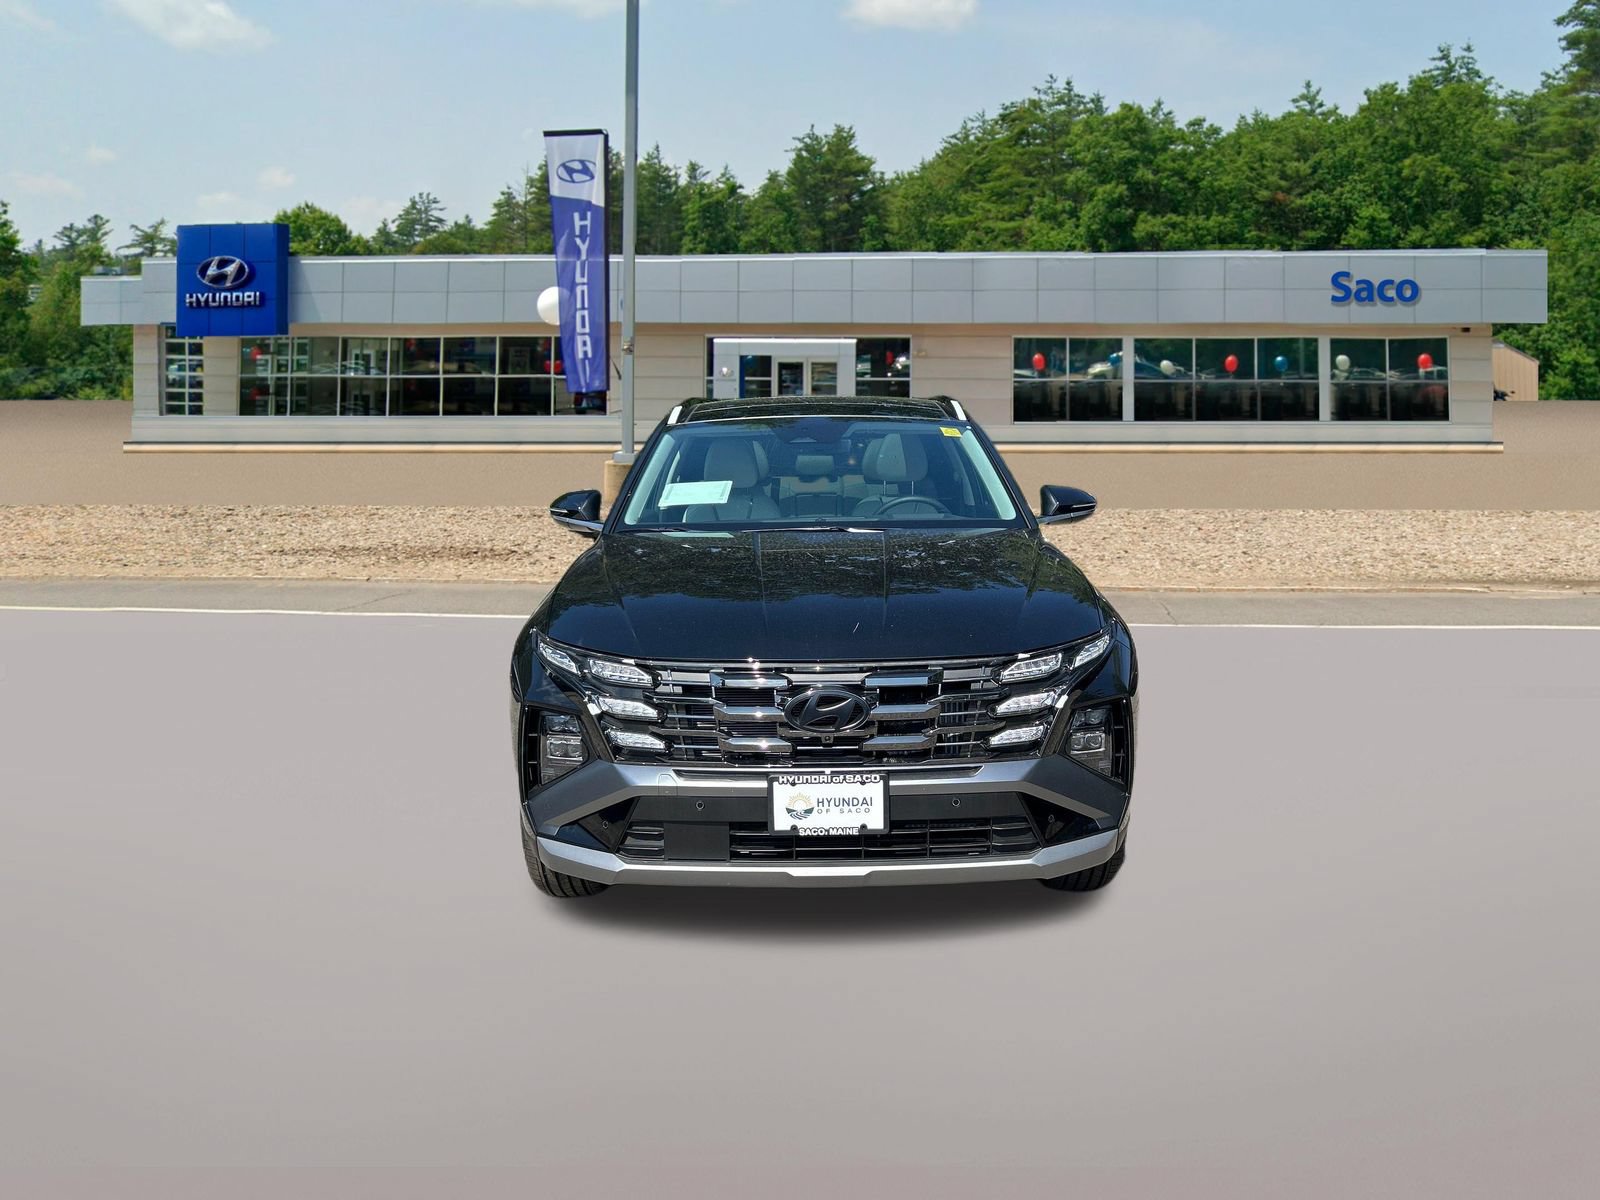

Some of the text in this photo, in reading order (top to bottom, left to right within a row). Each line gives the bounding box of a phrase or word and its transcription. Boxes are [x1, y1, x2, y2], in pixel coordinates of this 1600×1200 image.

[1331, 271, 1419, 303] Saco
[185, 291, 260, 307] HYUNDAI
[573, 211, 592, 383] HYUNDAI
[779, 775, 880, 784] HYUNDAI of SACO
[817, 797, 873, 808] HYUNDAI
